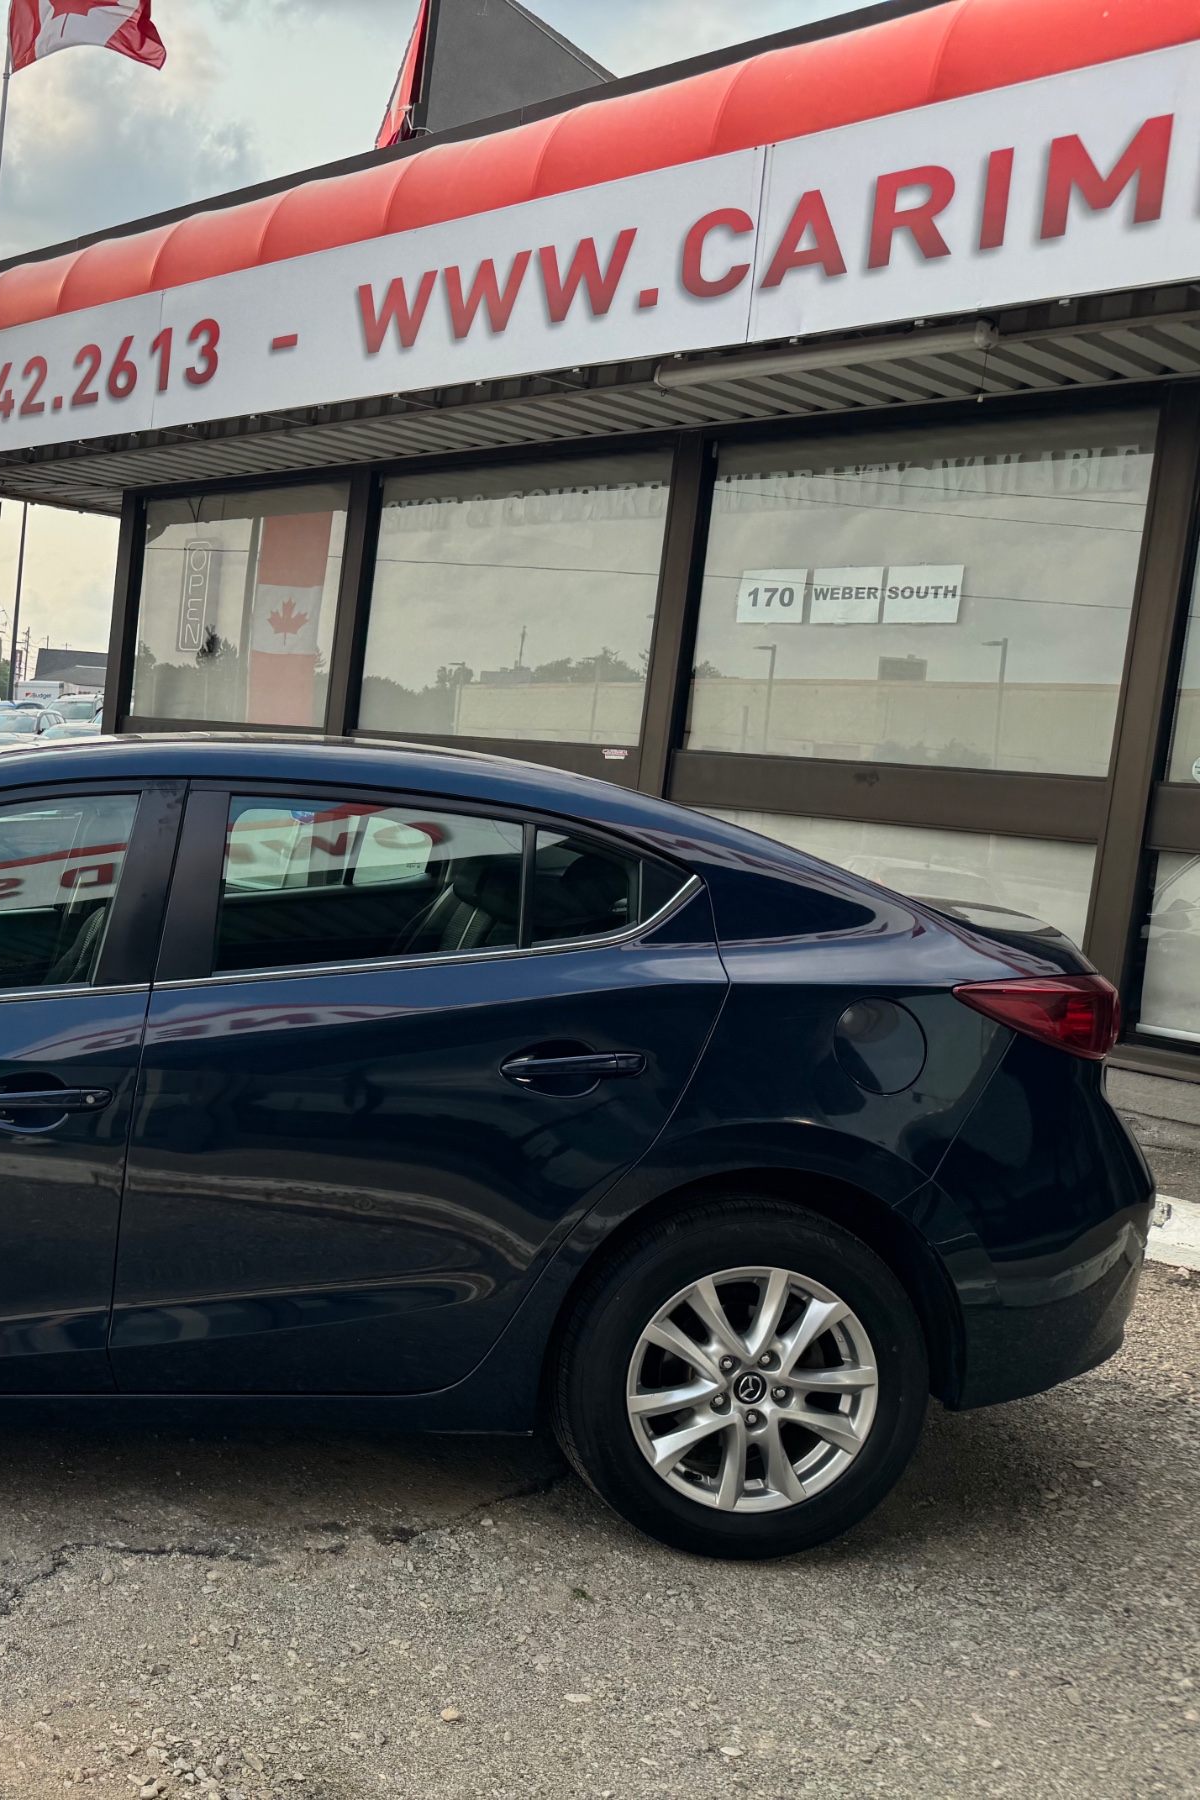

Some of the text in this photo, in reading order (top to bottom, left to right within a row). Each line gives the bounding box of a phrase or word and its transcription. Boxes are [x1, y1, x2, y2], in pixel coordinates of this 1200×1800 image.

[358, 113, 1200, 354] WWW.CARIM
[185, 548, 207, 645] OPEN
[747, 585, 958, 607] 170 WEBER SOUTH
